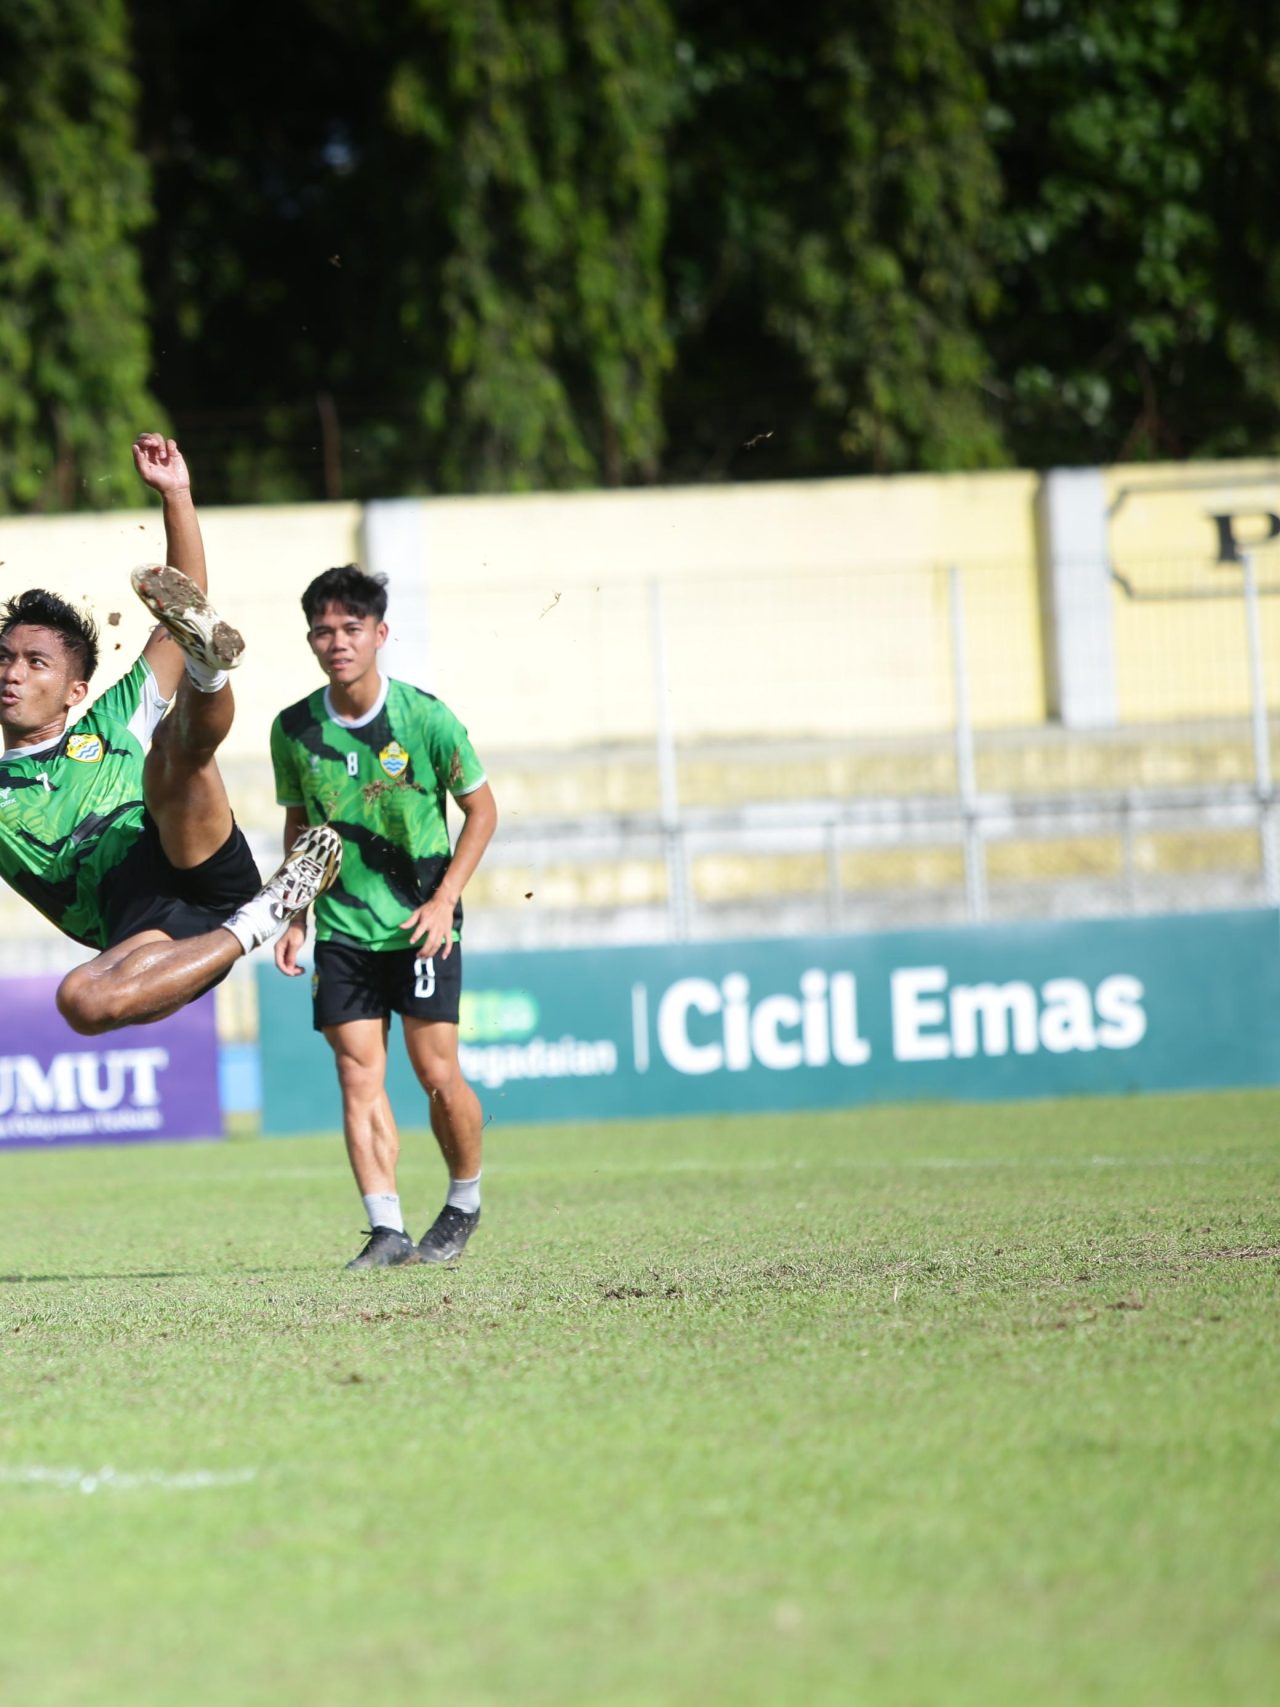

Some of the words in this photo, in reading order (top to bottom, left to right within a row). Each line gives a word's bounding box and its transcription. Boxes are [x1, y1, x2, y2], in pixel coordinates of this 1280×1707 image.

[36, 772, 51, 792] 7
[347, 752, 358, 776] 8
[414, 955, 435, 998] 8
[658, 969, 871, 1075] Cicil
[890, 966, 1147, 1061] Emas
[457, 1034, 617, 1088] egadaian
